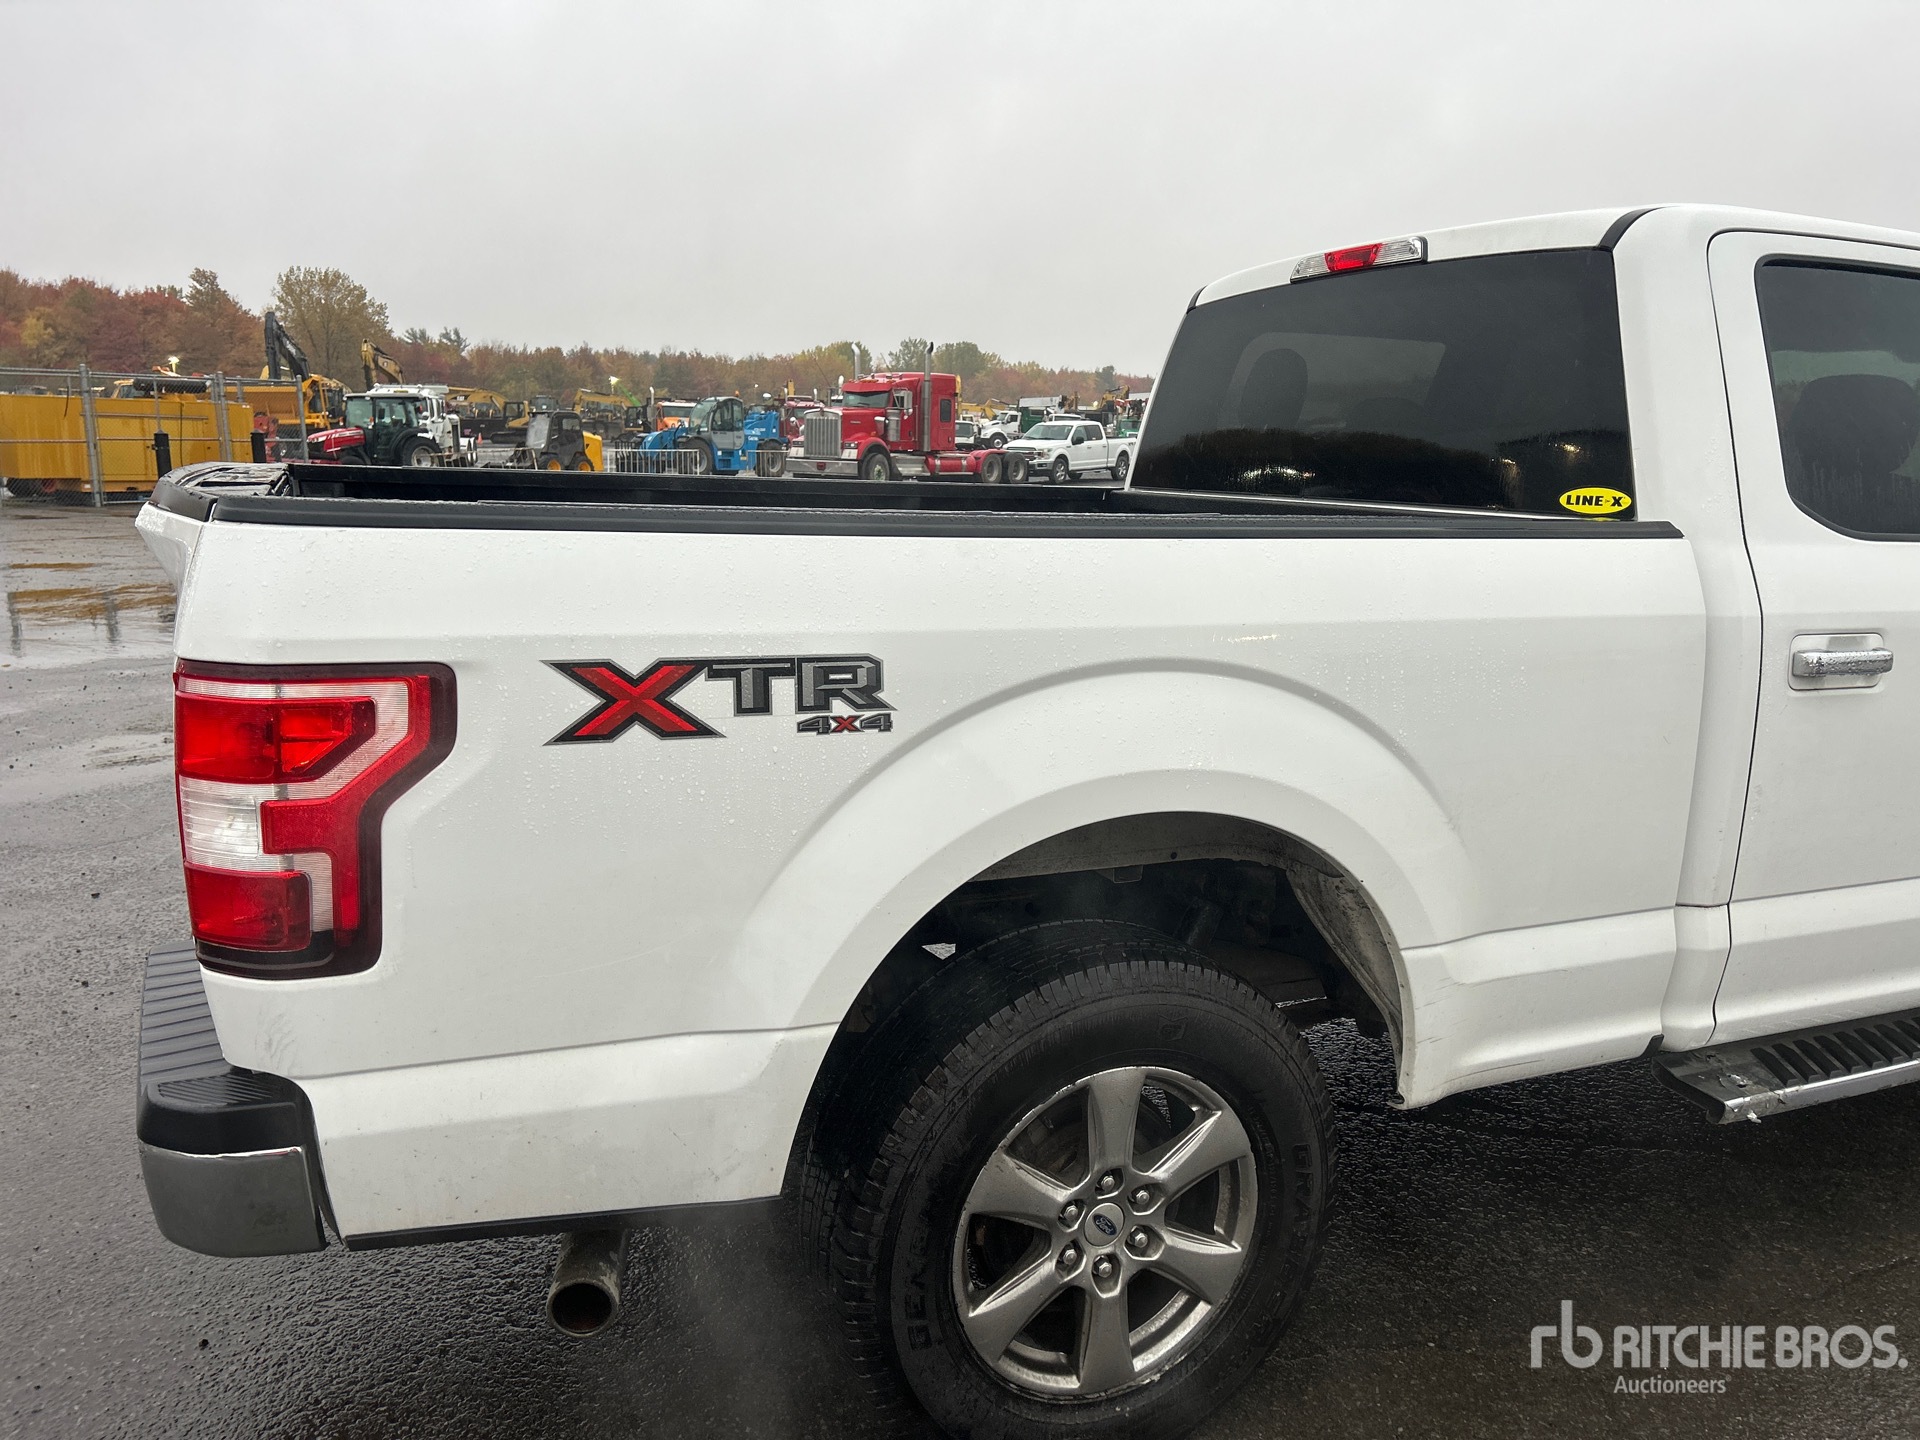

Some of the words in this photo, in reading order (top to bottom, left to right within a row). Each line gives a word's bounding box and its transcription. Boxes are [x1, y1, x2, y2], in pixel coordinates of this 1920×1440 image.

[1565, 494, 1624, 507] LINE-X
[539, 653, 898, 746] XTR
[1094, 1216, 1115, 1234] Ford
